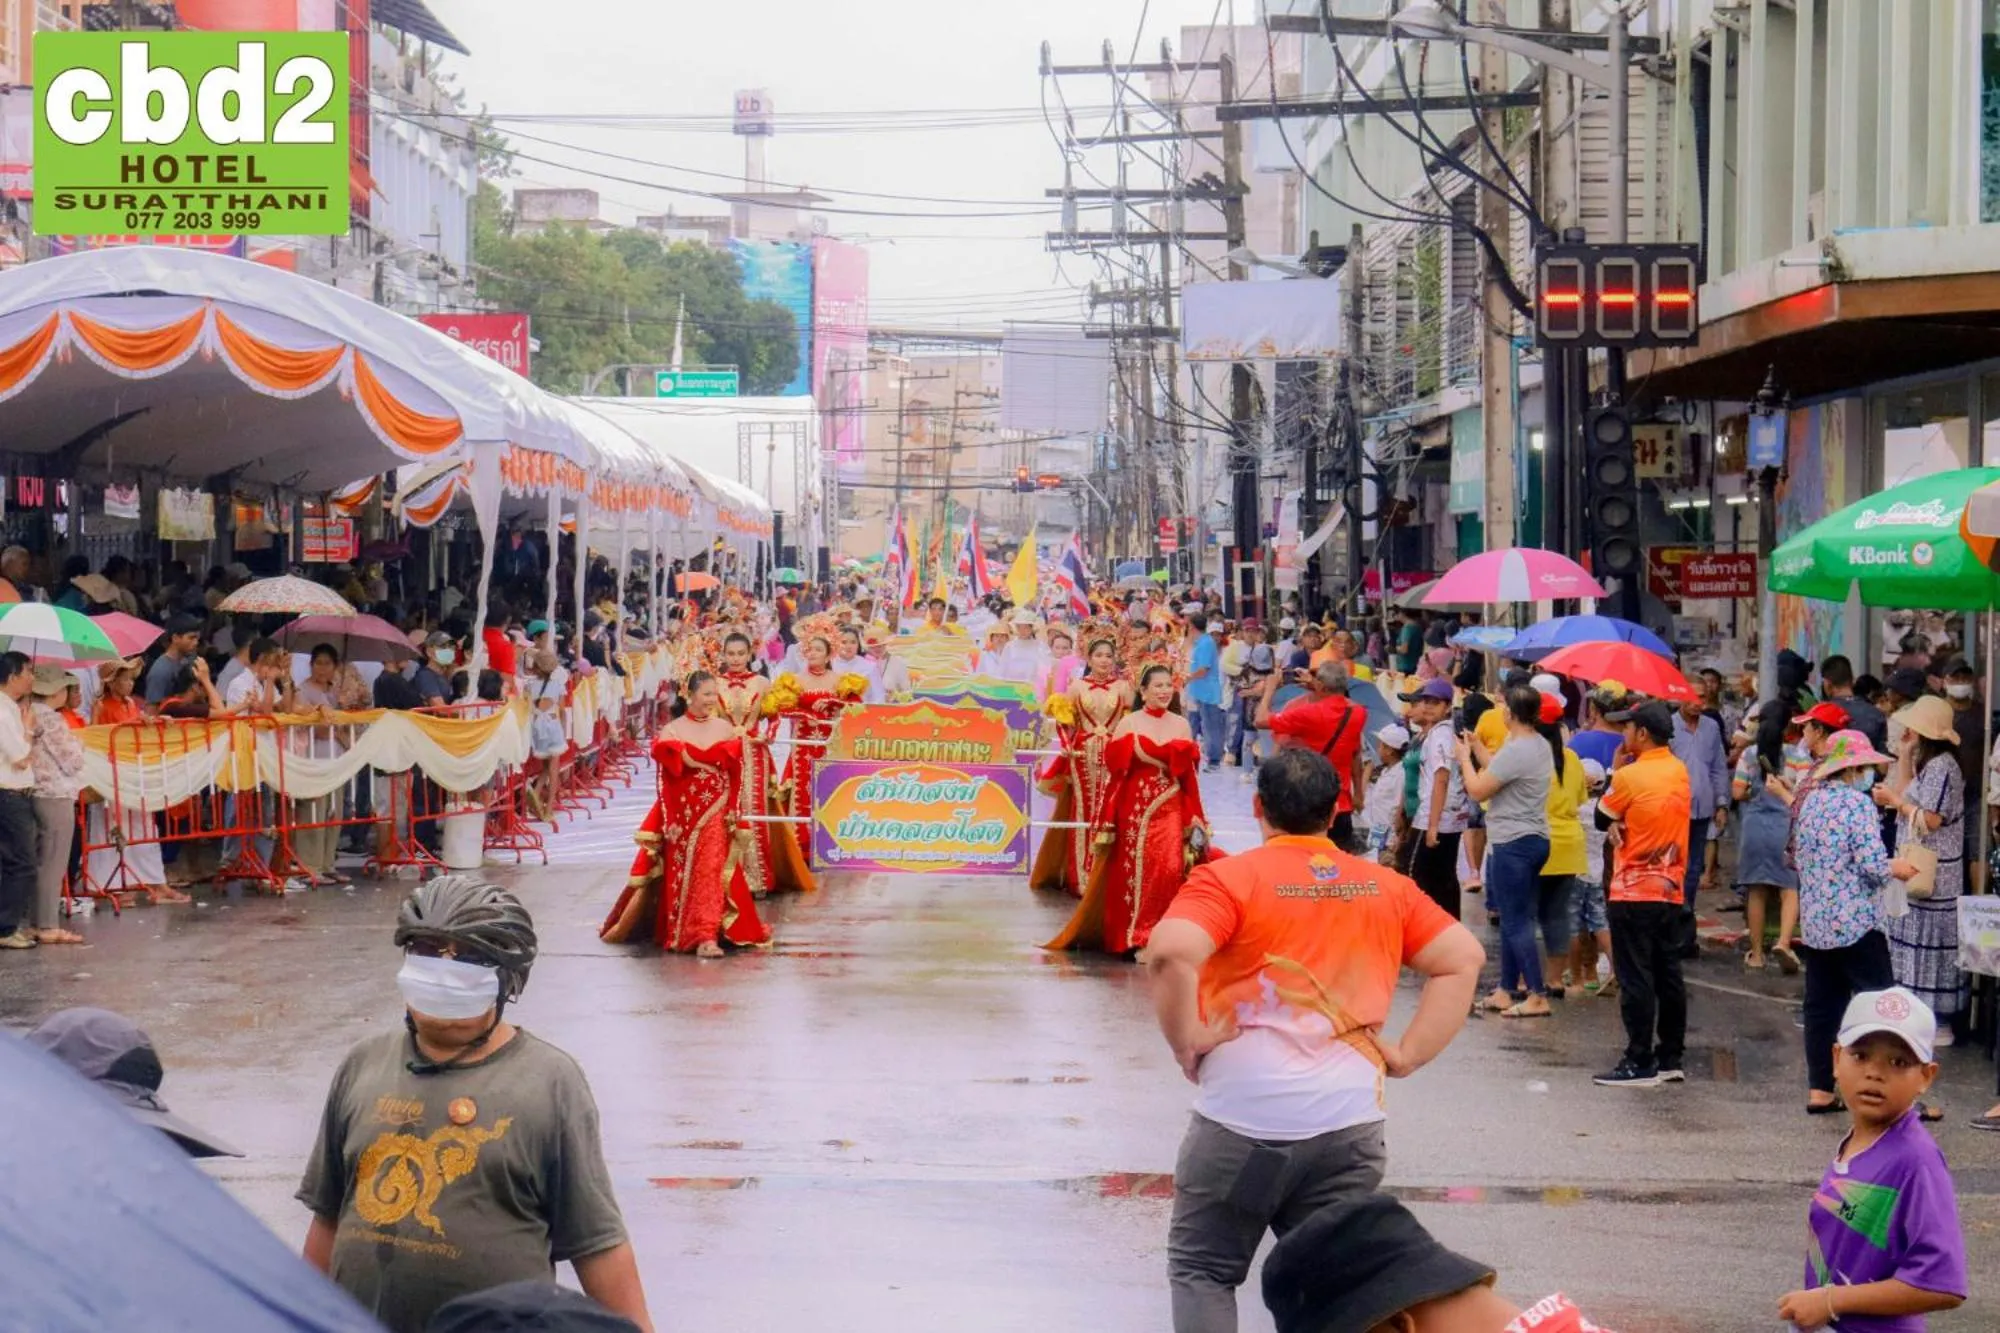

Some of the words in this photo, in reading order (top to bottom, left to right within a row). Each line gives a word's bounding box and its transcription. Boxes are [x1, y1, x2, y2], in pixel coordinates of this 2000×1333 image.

[1849, 544, 1909, 565] KBank
[854, 728, 992, 763] อำเภอท่าชนะ
[856, 772, 988, 804] สำนักสงฆ์
